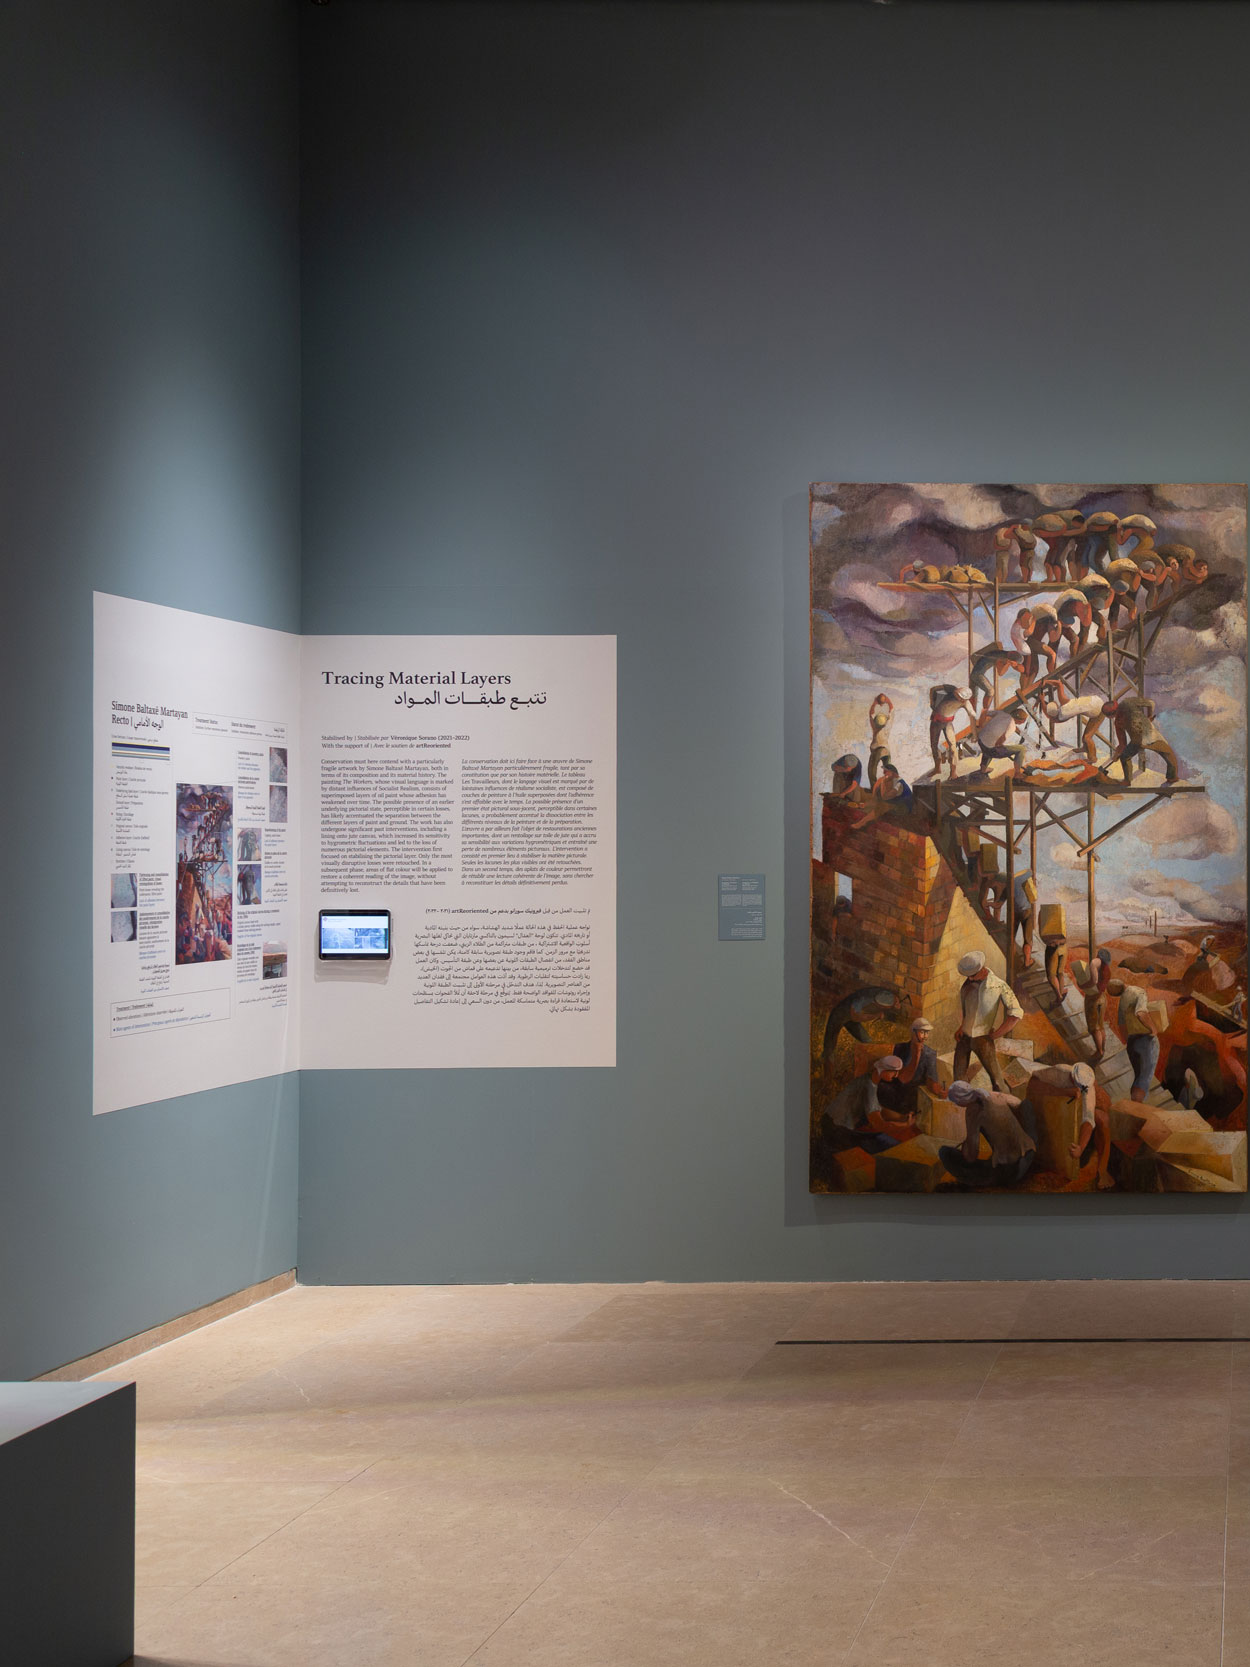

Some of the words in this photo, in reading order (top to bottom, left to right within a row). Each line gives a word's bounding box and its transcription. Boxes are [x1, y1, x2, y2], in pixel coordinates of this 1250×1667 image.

[322, 671, 385, 688] Tracing
[389, 671, 456, 685] Material
[461, 672, 511, 688] Layers
[394, 690, 440, 709] المواد
[445, 690, 506, 708] طبقات
[510, 692, 547, 710] تتبع
[112, 701, 135, 713] Simone
[136, 704, 159, 715] Baltaxé
[160, 707, 189, 720] Martayan
[112, 714, 130, 725] Recto
